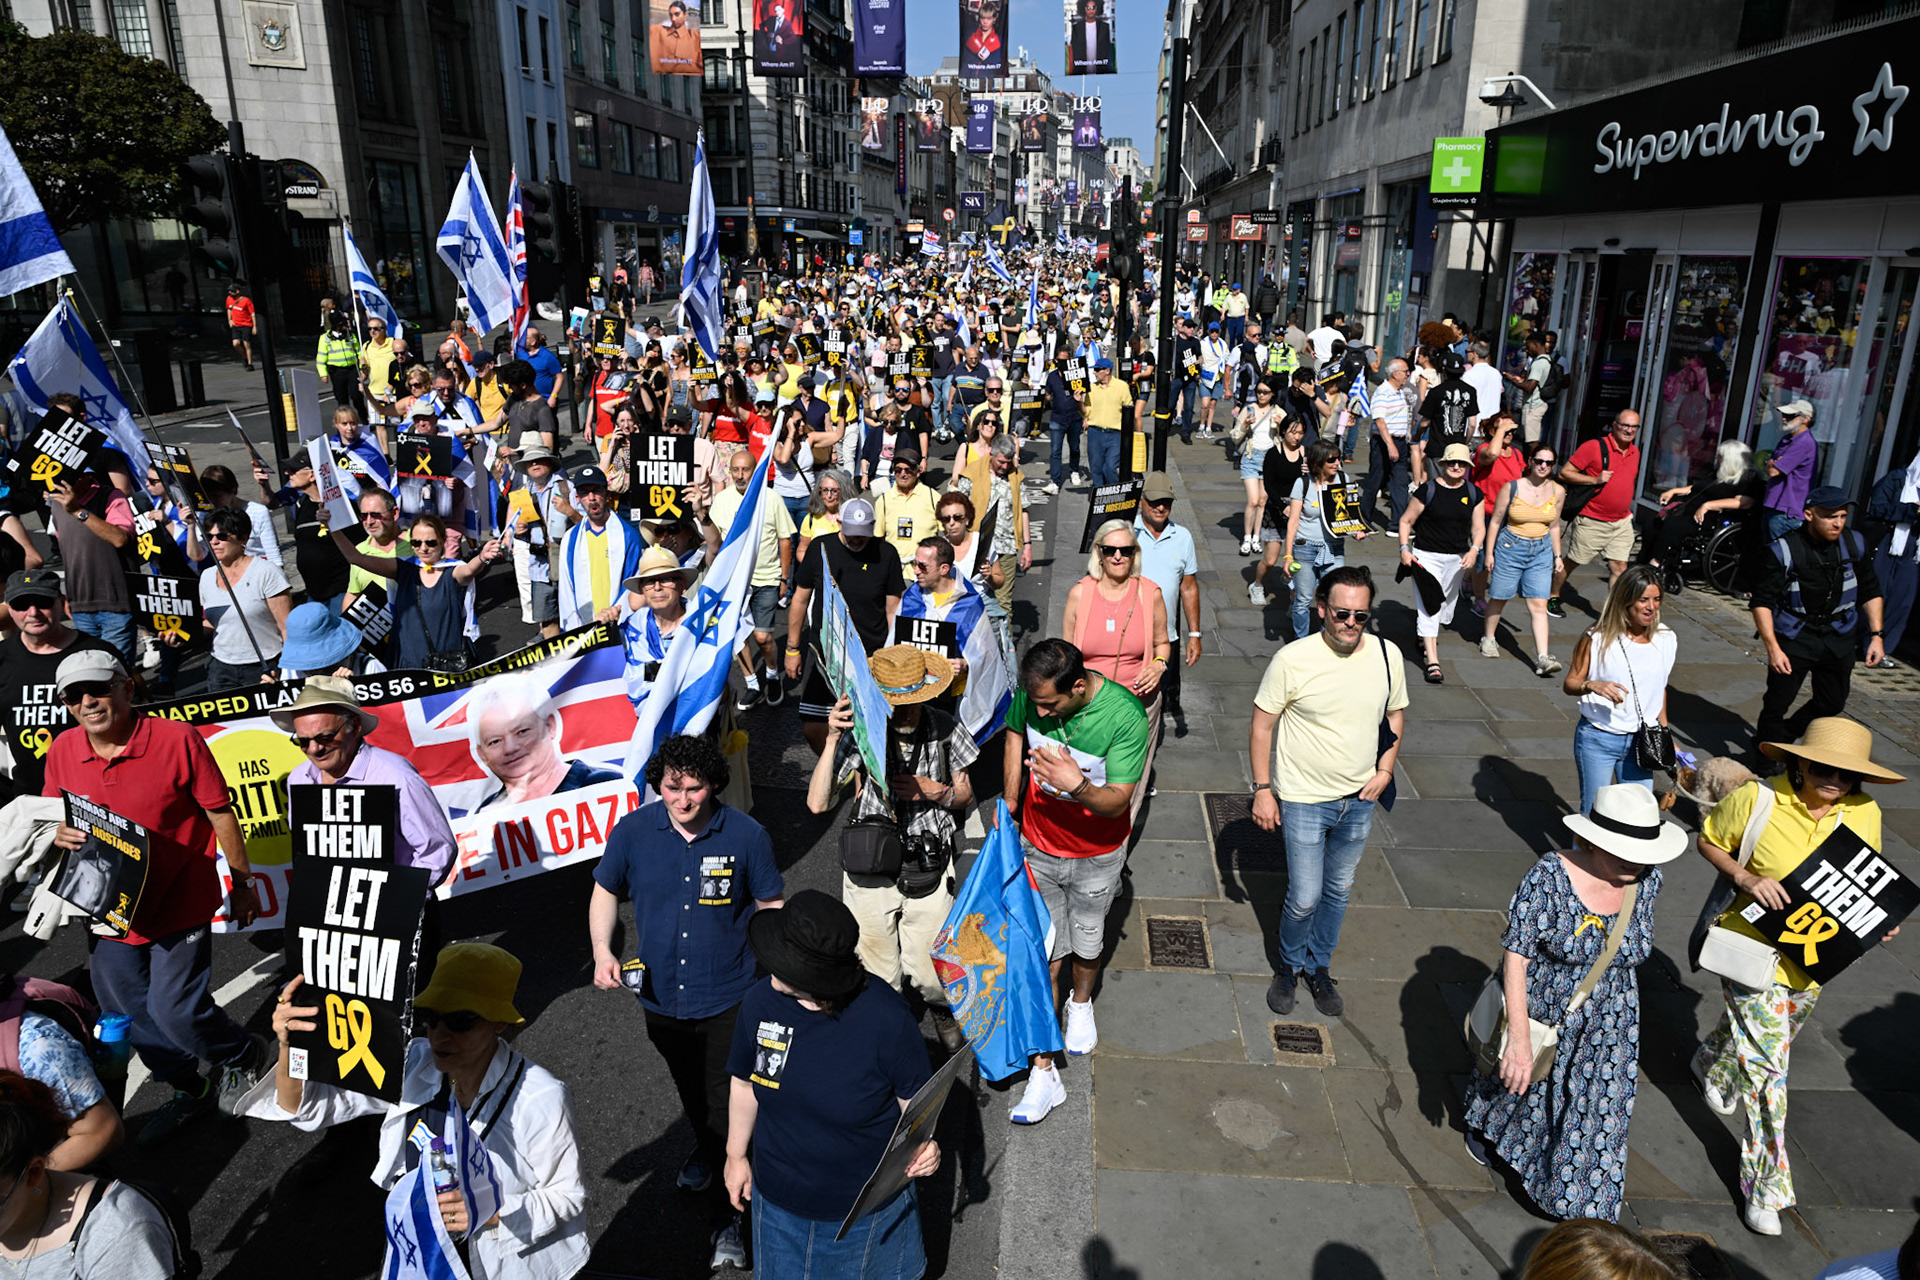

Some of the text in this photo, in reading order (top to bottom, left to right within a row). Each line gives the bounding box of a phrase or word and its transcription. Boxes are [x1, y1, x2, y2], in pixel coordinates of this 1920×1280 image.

[761, 61, 778, 69] Where
[780, 61, 789, 69] Am
[1436, 142, 1482, 154] Pharmacy
[1594, 102, 1825, 180] Superdrug
[288, 186, 318, 195] STRAND
[965, 197, 981, 206] SIX
[1432, 197, 1469, 205] Superdrug
[1238, 226, 1256, 236] Hut
[736, 307, 753, 318] THEM
[738, 302, 748, 310] LET
[982, 322, 1000, 333] THEM
[984, 315, 995, 324] LET
[738, 326, 748, 336] LET
[828, 330, 842, 341] LET
[823, 339, 846, 352] THEM
[1183, 348, 1192, 358] LET
[894, 352, 906, 364] LET
[1066, 358, 1080, 368] LET
[1182, 355, 1198, 368] THEM
[889, 362, 910, 376] THEM
[1063, 366, 1086, 382] THEM
[58, 416, 92, 446] LET
[33, 428, 88, 470] THEM
[648, 436, 676, 460] LET
[636, 460, 688, 486] THEM
[1094, 492, 1126, 505] STARVING
[1096, 482, 1134, 496] HAMAS ARE
[650, 484, 682, 518] GO
[1092, 499, 1136, 514] THE HOSTAGES
[1331, 524, 1366, 534] HOSTAGES
[148, 576, 179, 598] LET
[136, 594, 194, 617] THEM
[348, 593, 379, 625] LET
[912, 620, 940, 644] LET
[148, 695, 250, 722] NAPPED
[389, 677, 415, 697] 56
[433, 661, 501, 688] BRING
[506, 646, 545, 670] HIM
[548, 626, 610, 658] HOME
[22, 684, 57, 705] LET
[12, 706, 68, 726] THEM
[238, 758, 270, 778] HAS
[68, 792, 128, 831] HAMAS ARE
[322, 788, 366, 823] LET
[70, 804, 121, 838] STARVING
[72, 814, 141, 862] THE HOSTAGES
[303, 824, 382, 859] THEM
[492, 816, 540, 872] IN
[1842, 846, 1900, 898] LET
[324, 865, 388, 931] LET
[1800, 858, 1889, 940] THEM
[106, 913, 130, 931] HOSTAGES
[1778, 901, 1840, 967] GO
[298, 926, 400, 1002] THEM
[325, 993, 386, 1090] GO
